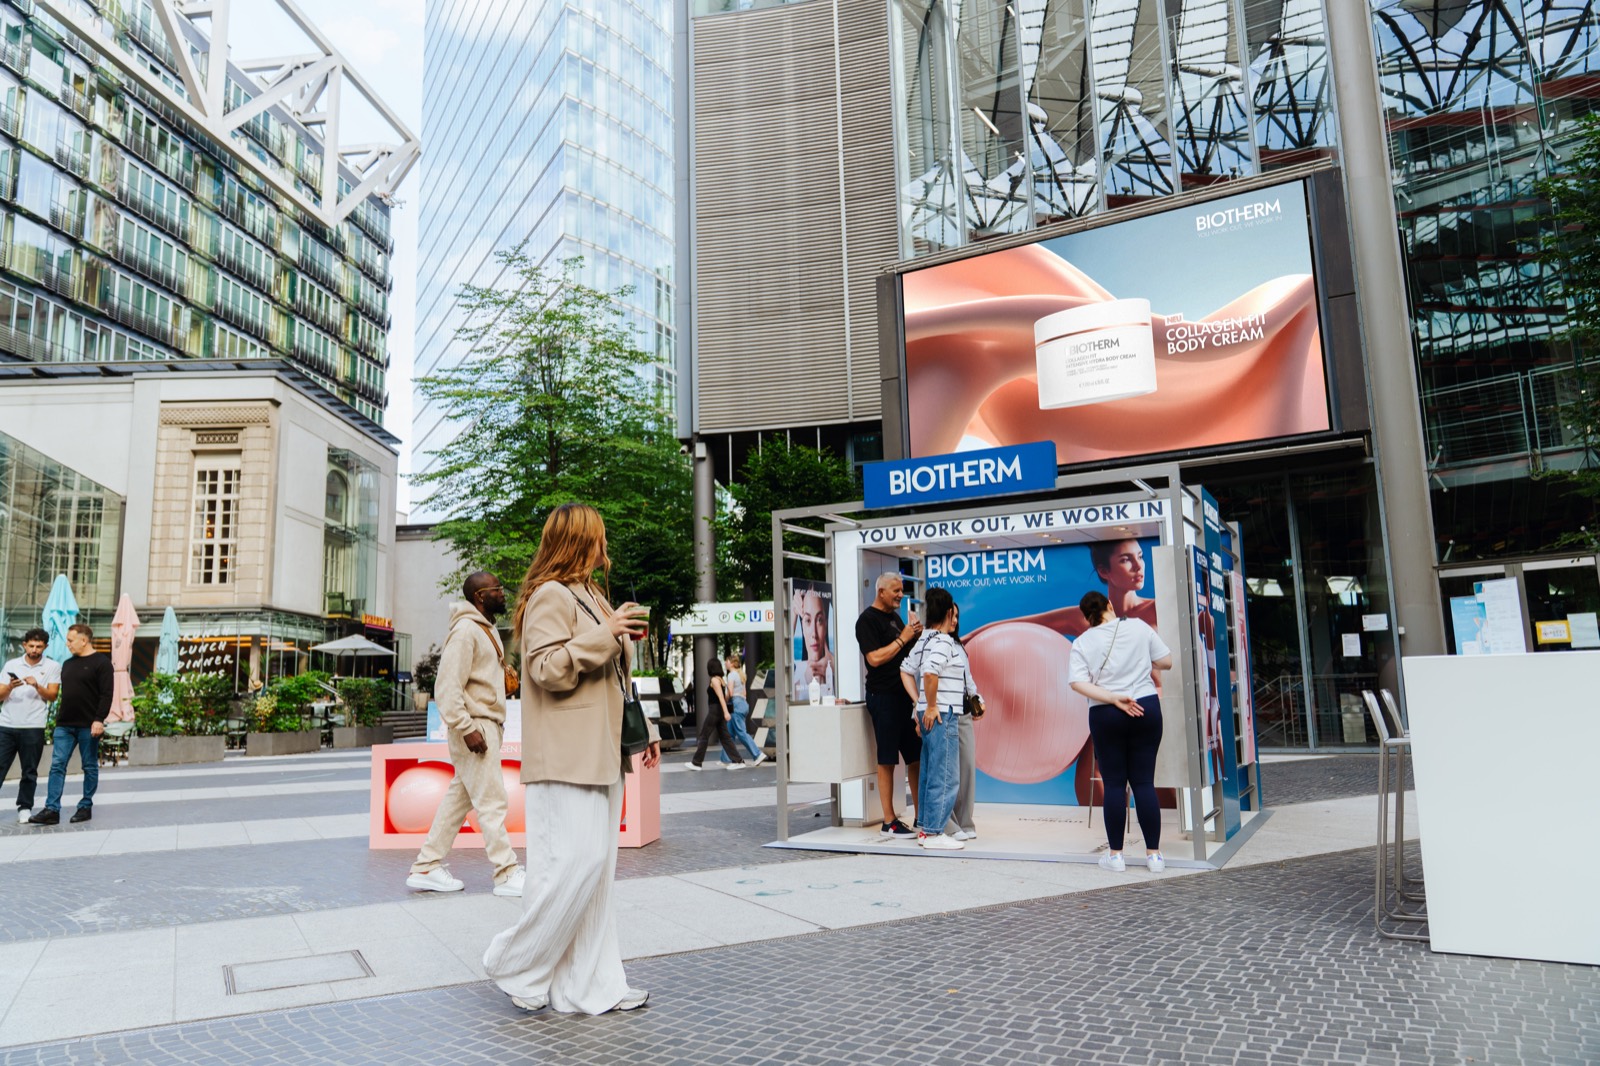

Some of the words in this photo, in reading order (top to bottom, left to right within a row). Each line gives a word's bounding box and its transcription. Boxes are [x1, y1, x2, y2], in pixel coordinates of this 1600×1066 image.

[1196, 198, 1281, 231] BIOTHERM
[1166, 318, 1243, 341] COLLAGEN
[1248, 313, 1266, 327] FIT
[1167, 315, 1182, 323] NEU
[1070, 337, 1120, 355] BIOTHERM
[1167, 336, 1207, 355] BODY
[1212, 326, 1264, 346] CREAM
[889, 454, 1022, 496] BIOTHERM
[859, 527, 896, 543] YOU
[904, 521, 963, 539] WORK
[971, 516, 1015, 533] OUT,
[1023, 512, 1054, 528] WE
[1062, 504, 1129, 524] WORK
[1139, 500, 1163, 518] IN
[927, 548, 1046, 578] BIOTHERM
[928, 581, 945, 589] YOU
[947, 579, 971, 588] WORK
[973, 577, 991, 587] OUT,
[993, 576, 1007, 585] WE
[1009, 575, 1035, 584] WORK
[1037, 574, 1047, 583] IN
[751, 610, 760, 622] U
[177, 626, 230, 641] RUNCH
[179, 641, 227, 656] LUNCH
[177, 654, 233, 670] DINNER
